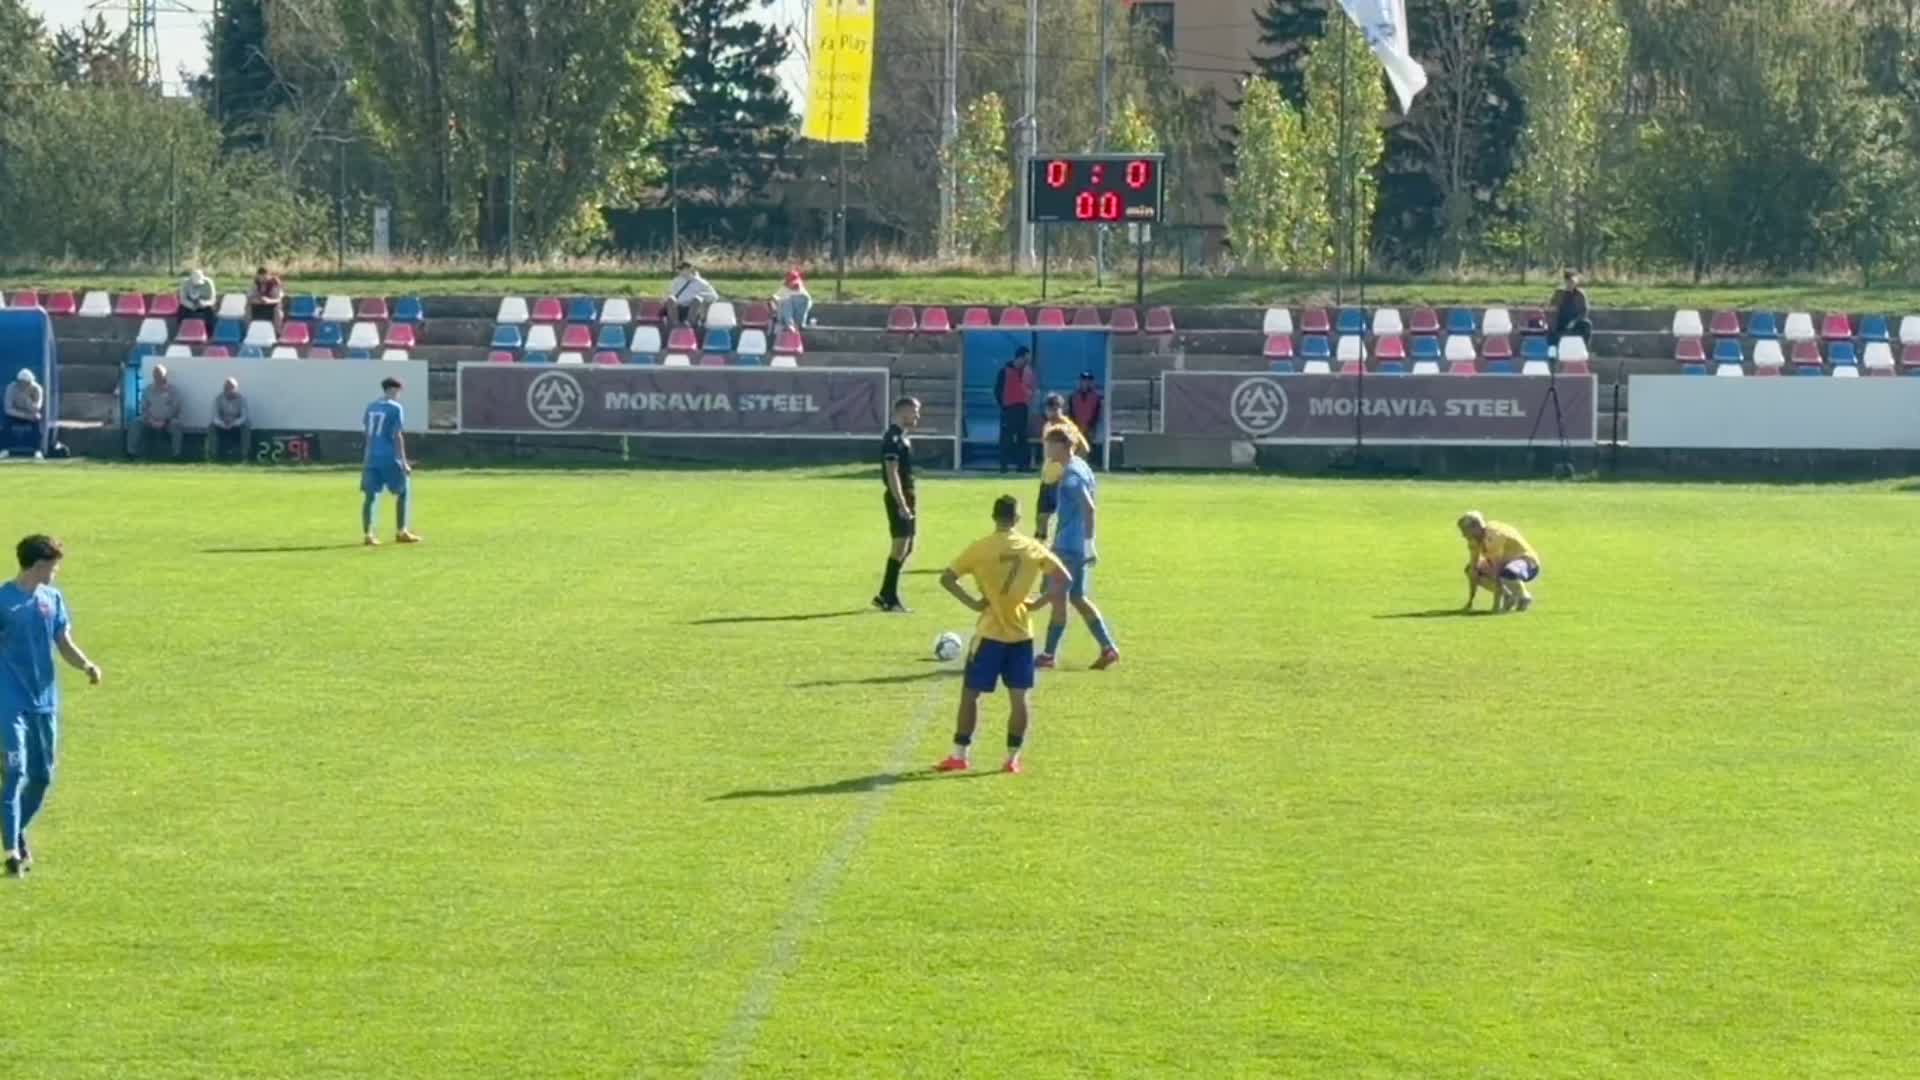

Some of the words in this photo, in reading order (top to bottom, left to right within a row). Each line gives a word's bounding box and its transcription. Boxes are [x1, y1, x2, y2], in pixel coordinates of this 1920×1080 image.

[1047, 160, 1067, 188] 0
[1126, 160, 1148, 188] 0
[1075, 191, 1118, 219] 00
[604, 391, 731, 412] MORAVIA
[738, 393, 820, 413] STEEL
[1308, 397, 1437, 417] MORAVIA
[1444, 398, 1527, 417] STEEL
[367, 410, 386, 436] 17
[999, 554, 1022, 595] 7
